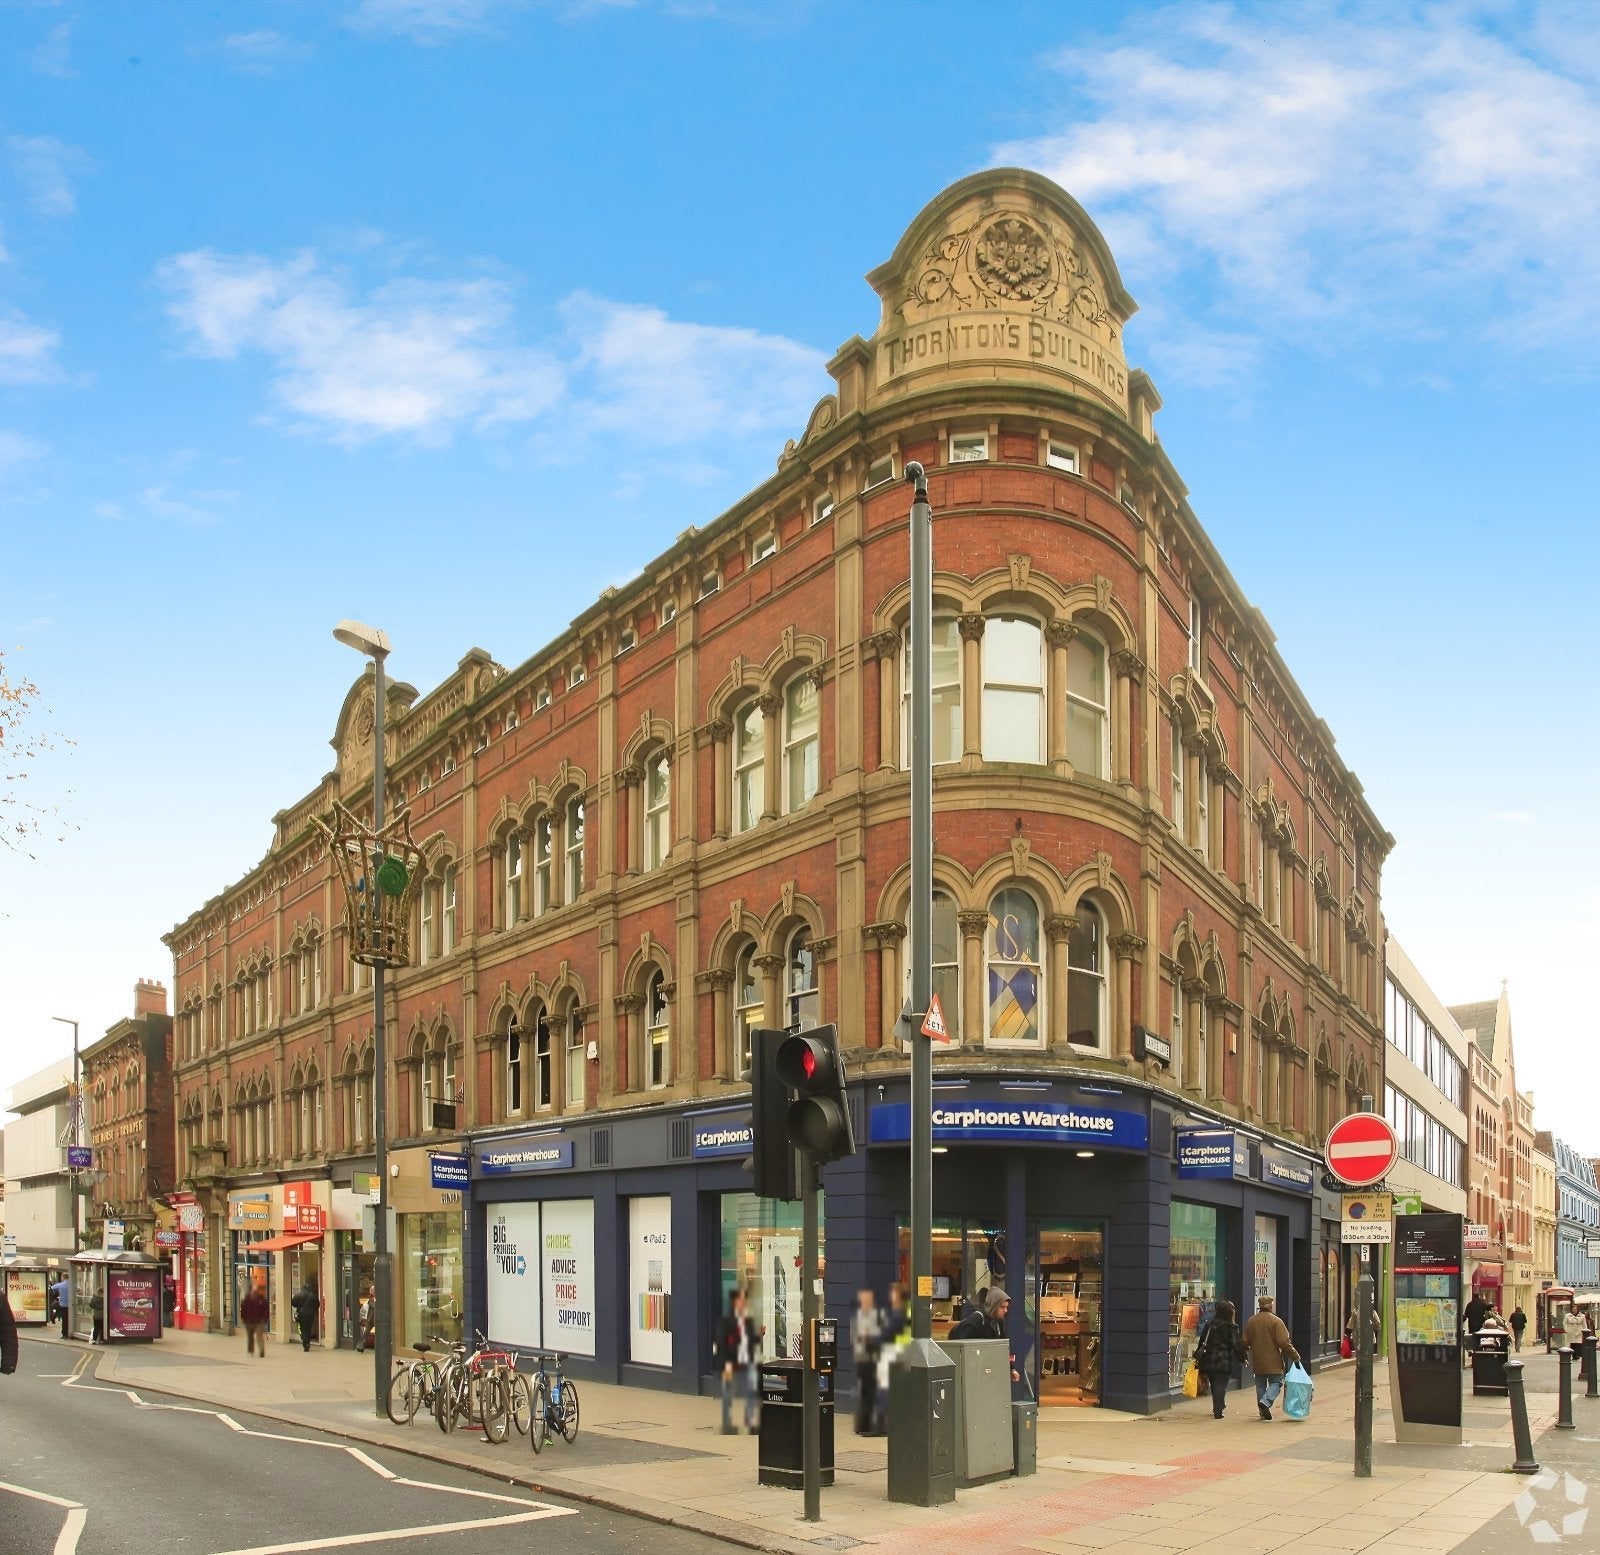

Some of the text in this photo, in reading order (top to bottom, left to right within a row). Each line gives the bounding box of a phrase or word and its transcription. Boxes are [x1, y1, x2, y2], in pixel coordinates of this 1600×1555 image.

[885, 316, 1125, 396] THORNTON'S BUILDINGS
[932, 1109, 1114, 1131] Carphone Warehouse
[701, 1129, 750, 1146] Carphone
[493, 1153, 522, 1165] Carphone
[523, 1149, 560, 1161] Warehouse
[1186, 1145, 1231, 1156] Carphone
[1181, 1155, 1231, 1165] Warehouse
[434, 1172, 468, 1181] Warehouse
[437, 1165, 468, 1175] Carphone
[493, 1225, 507, 1243] BIG
[546, 1234, 571, 1249] CHOICE
[649, 1234, 662, 1244] iPad
[493, 1244, 517, 1255] PROMISES
[501, 1256, 516, 1274] YOU
[551, 1259, 577, 1274] ADVICE
[117, 1280, 152, 1288] Christmas
[555, 1283, 577, 1300] PRICE
[558, 1309, 591, 1327] SUPPORT
